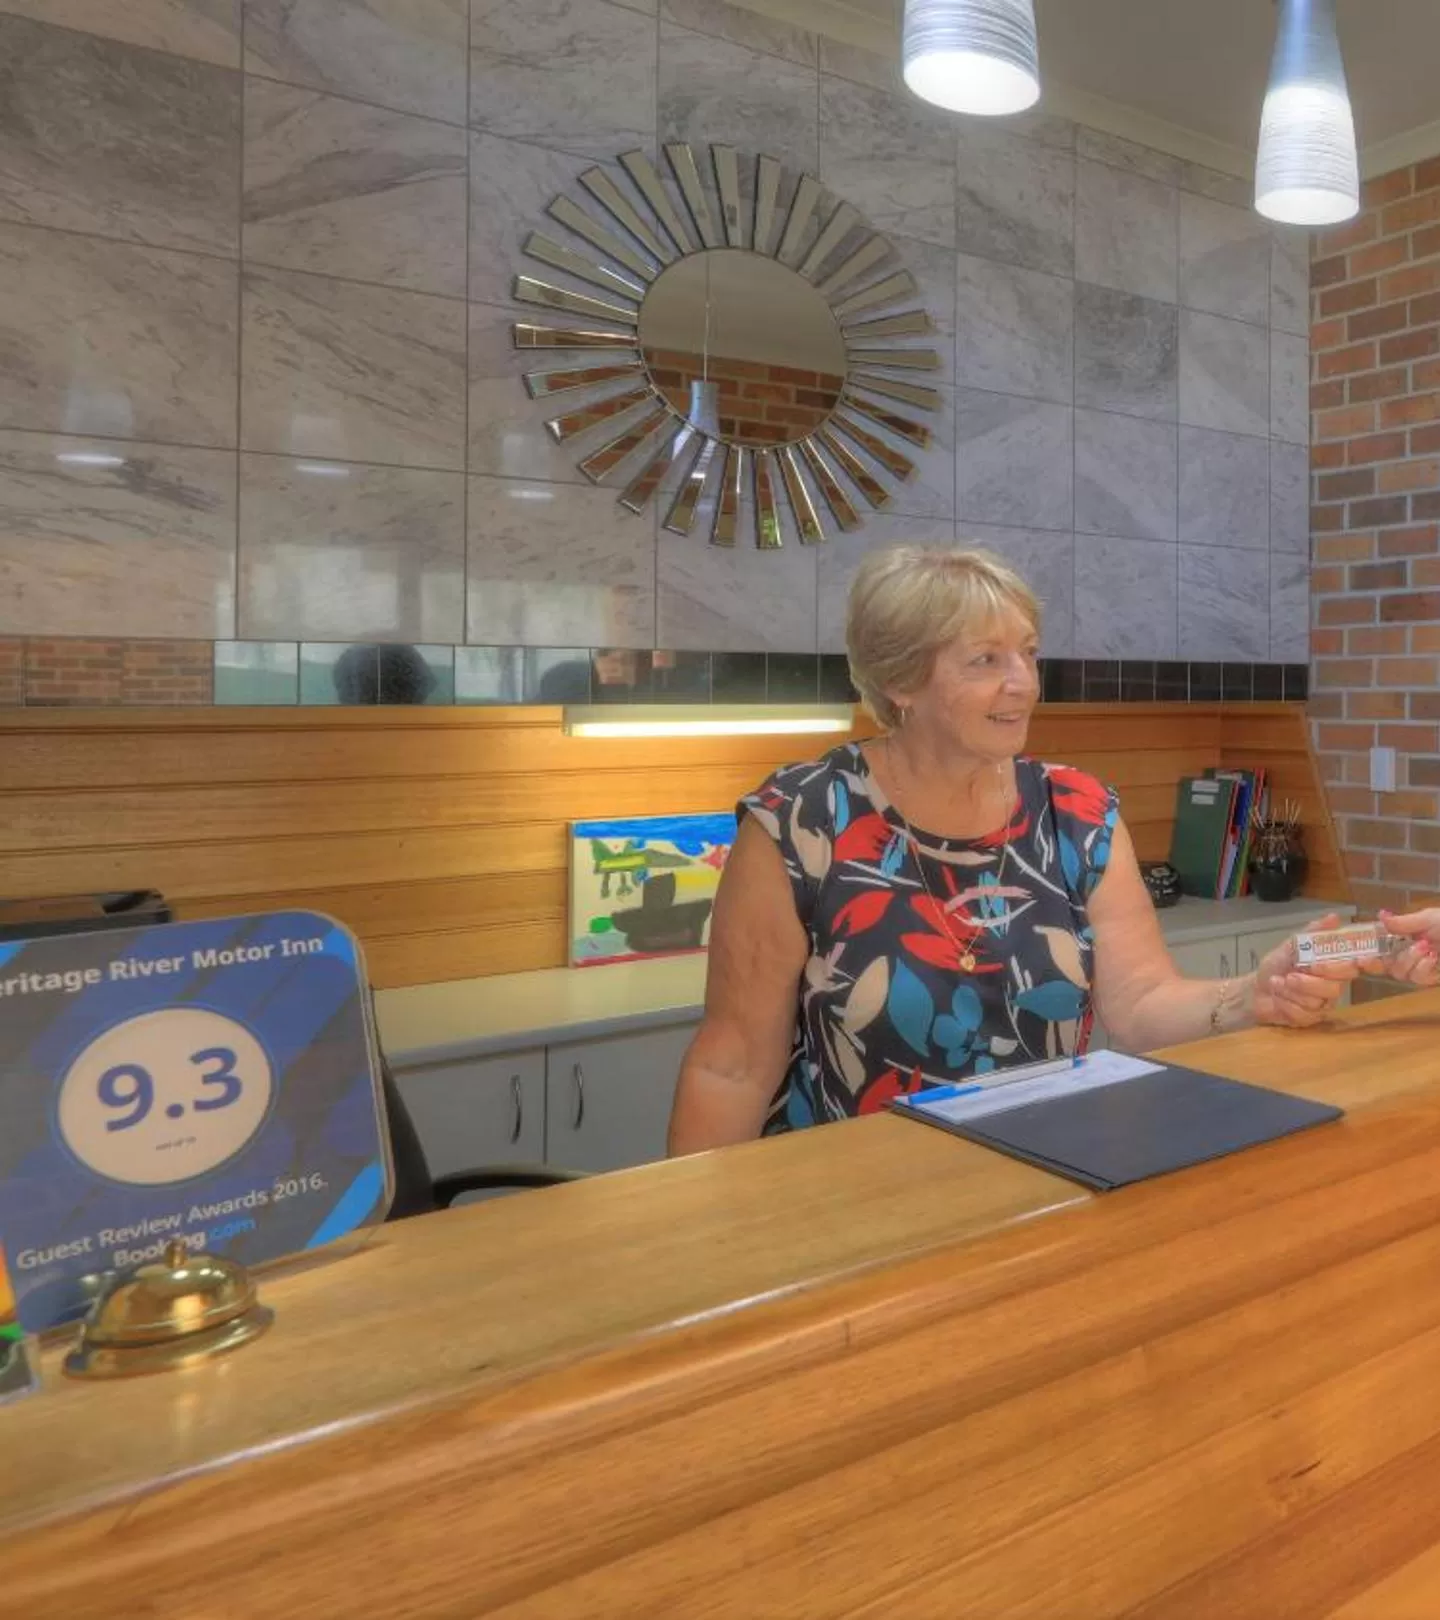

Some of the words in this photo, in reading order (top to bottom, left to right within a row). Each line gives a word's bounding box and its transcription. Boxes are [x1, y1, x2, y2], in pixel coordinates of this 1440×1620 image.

[0, 966, 103, 998] ritage
[109, 955, 186, 981] River
[192, 943, 276, 969] Motor
[280, 936, 325, 957] Inn
[97, 1047, 242, 1133] 9.3
[16, 1236, 93, 1271] Guest
[97, 1213, 183, 1248] Review
[187, 1189, 269, 1223] Awards
